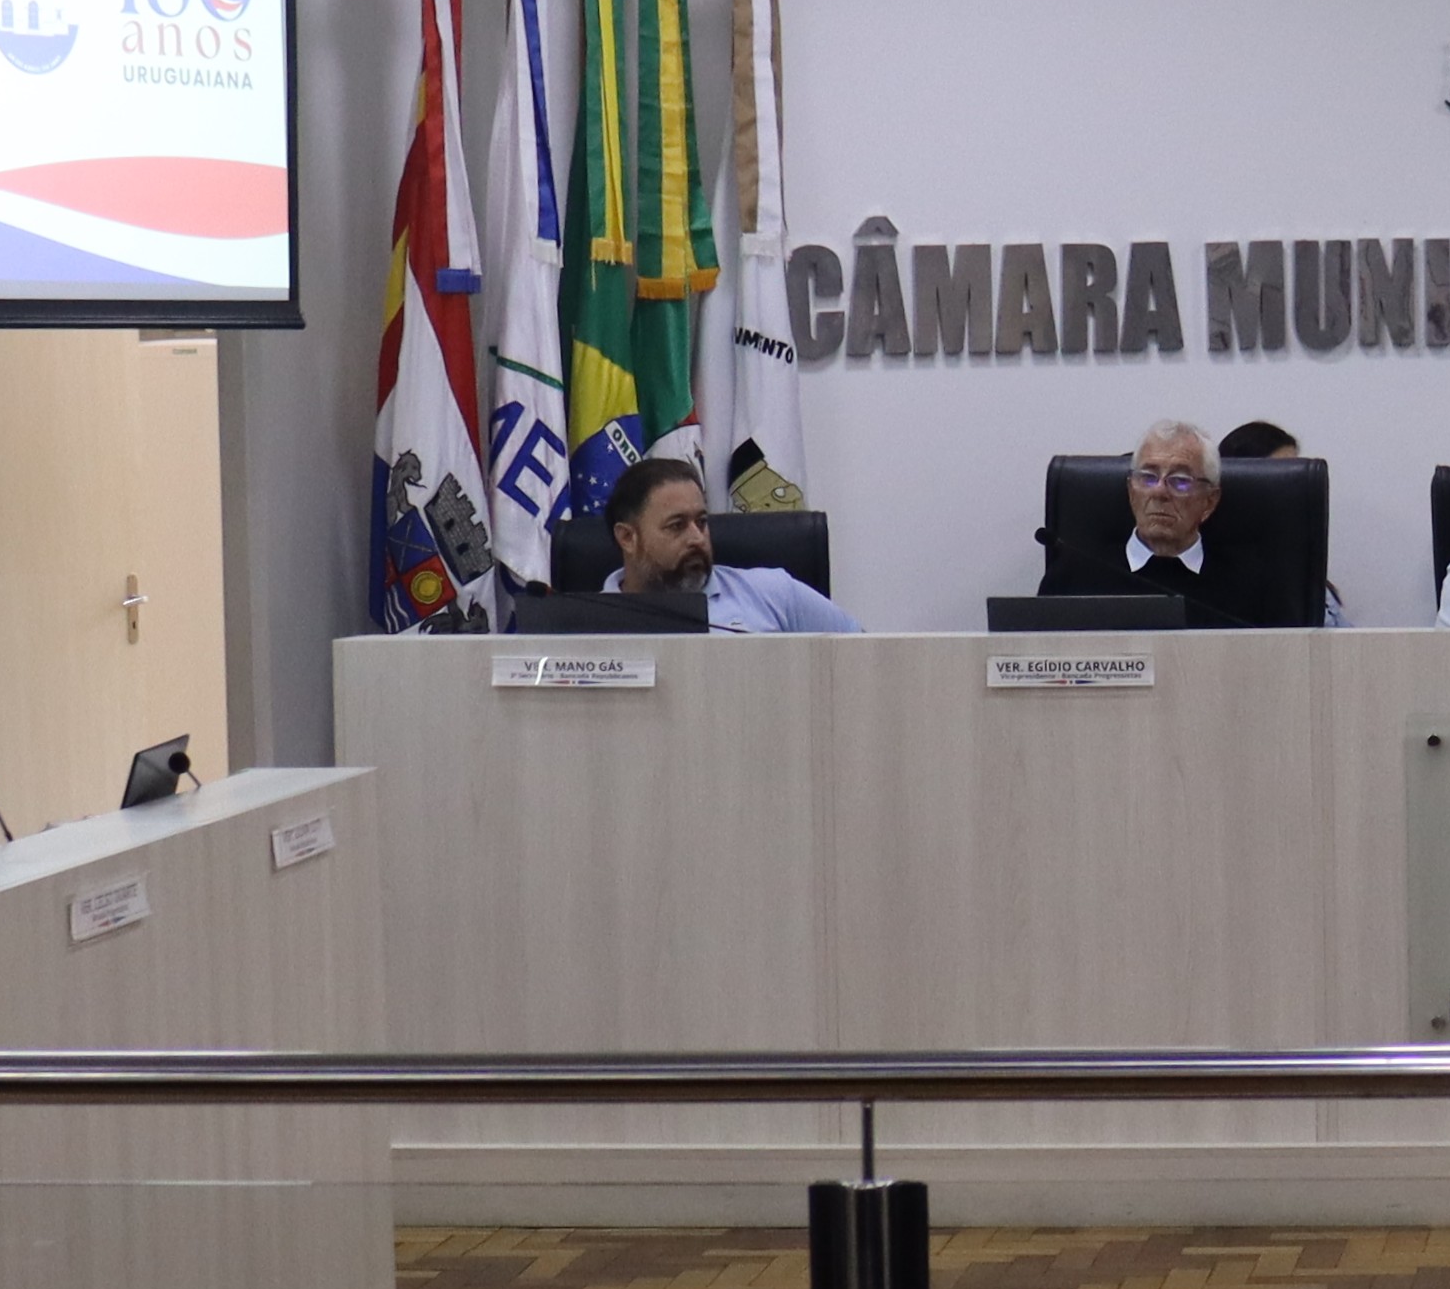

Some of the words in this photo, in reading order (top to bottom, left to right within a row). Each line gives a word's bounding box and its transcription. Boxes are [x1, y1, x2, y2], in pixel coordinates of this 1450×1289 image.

[121, 20, 253, 62] anos
[123, 64, 254, 90] URUGUAIANA
[785, 216, 1184, 361] CÂMARA
[613, 428, 637, 464] ORD
[555, 661, 596, 672] MANO
[599, 659, 623, 672] GÁS
[996, 661, 1024, 673] VER.
[1028, 659, 1072, 672] EGÍDIO
[1076, 661, 1145, 672] CARVALHO
